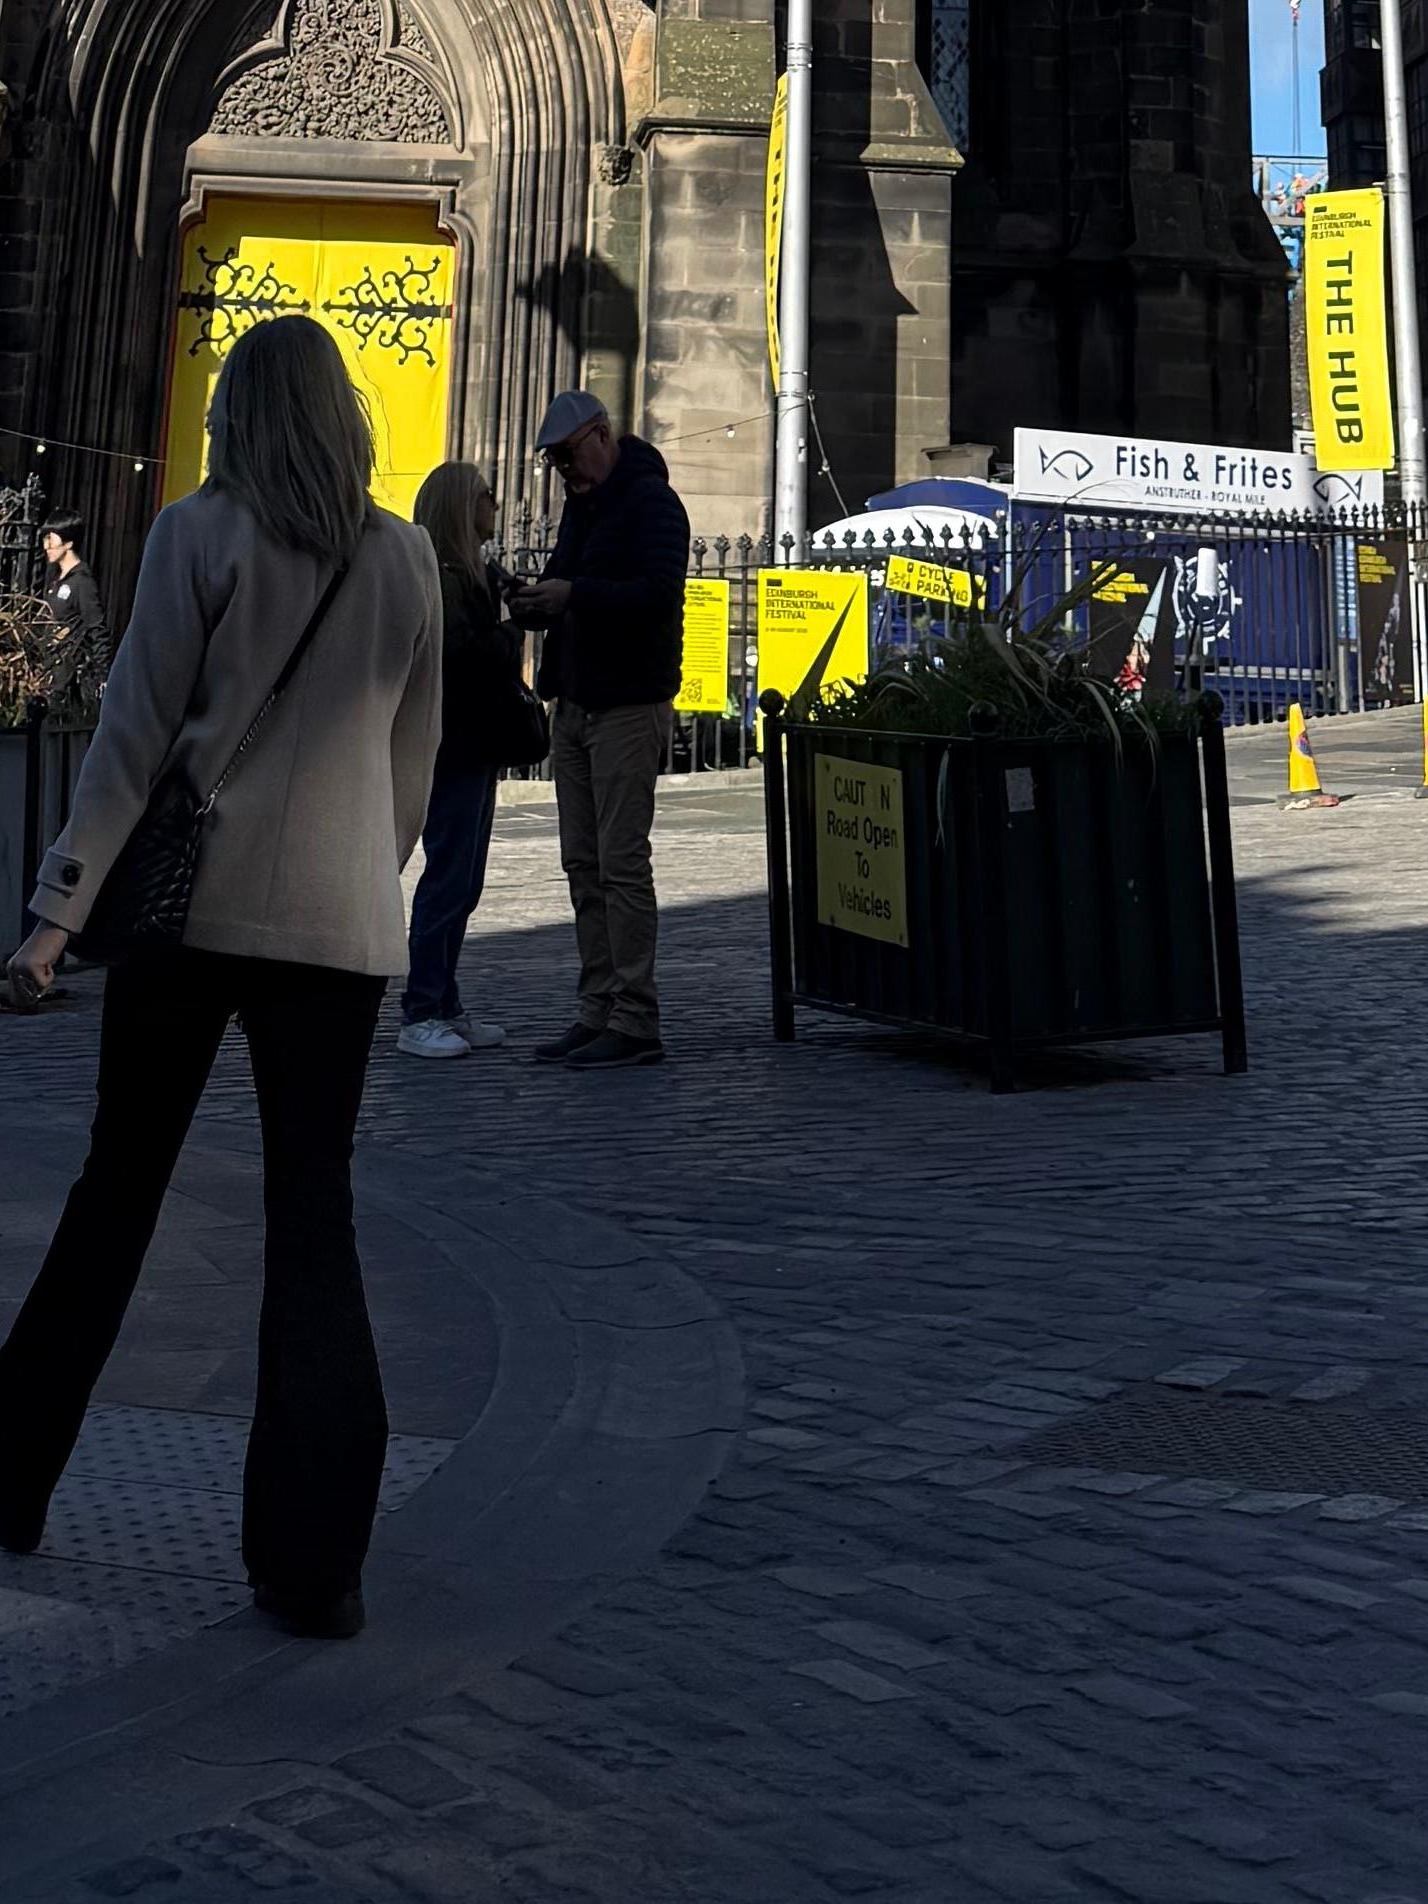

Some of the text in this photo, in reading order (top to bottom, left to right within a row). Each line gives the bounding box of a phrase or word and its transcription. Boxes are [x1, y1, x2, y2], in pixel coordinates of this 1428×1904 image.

[1326, 250, 1364, 445] THE HUB
[1116, 445, 1293, 491] Fish & Frites
[1144, 485, 1202, 500] ANSTRUTHER
[1211, 491, 1243, 504] ROYAL
[1245, 494, 1266, 506] MILE
[765, 588, 819, 600] EDINBURGH
[765, 598, 836, 611] INTERNATIONAL
[765, 609, 808, 621] FESTIVAL
[827, 809, 899, 850] Road Open
[854, 850, 870, 879] To
[837, 882, 892, 920] Vehicles
